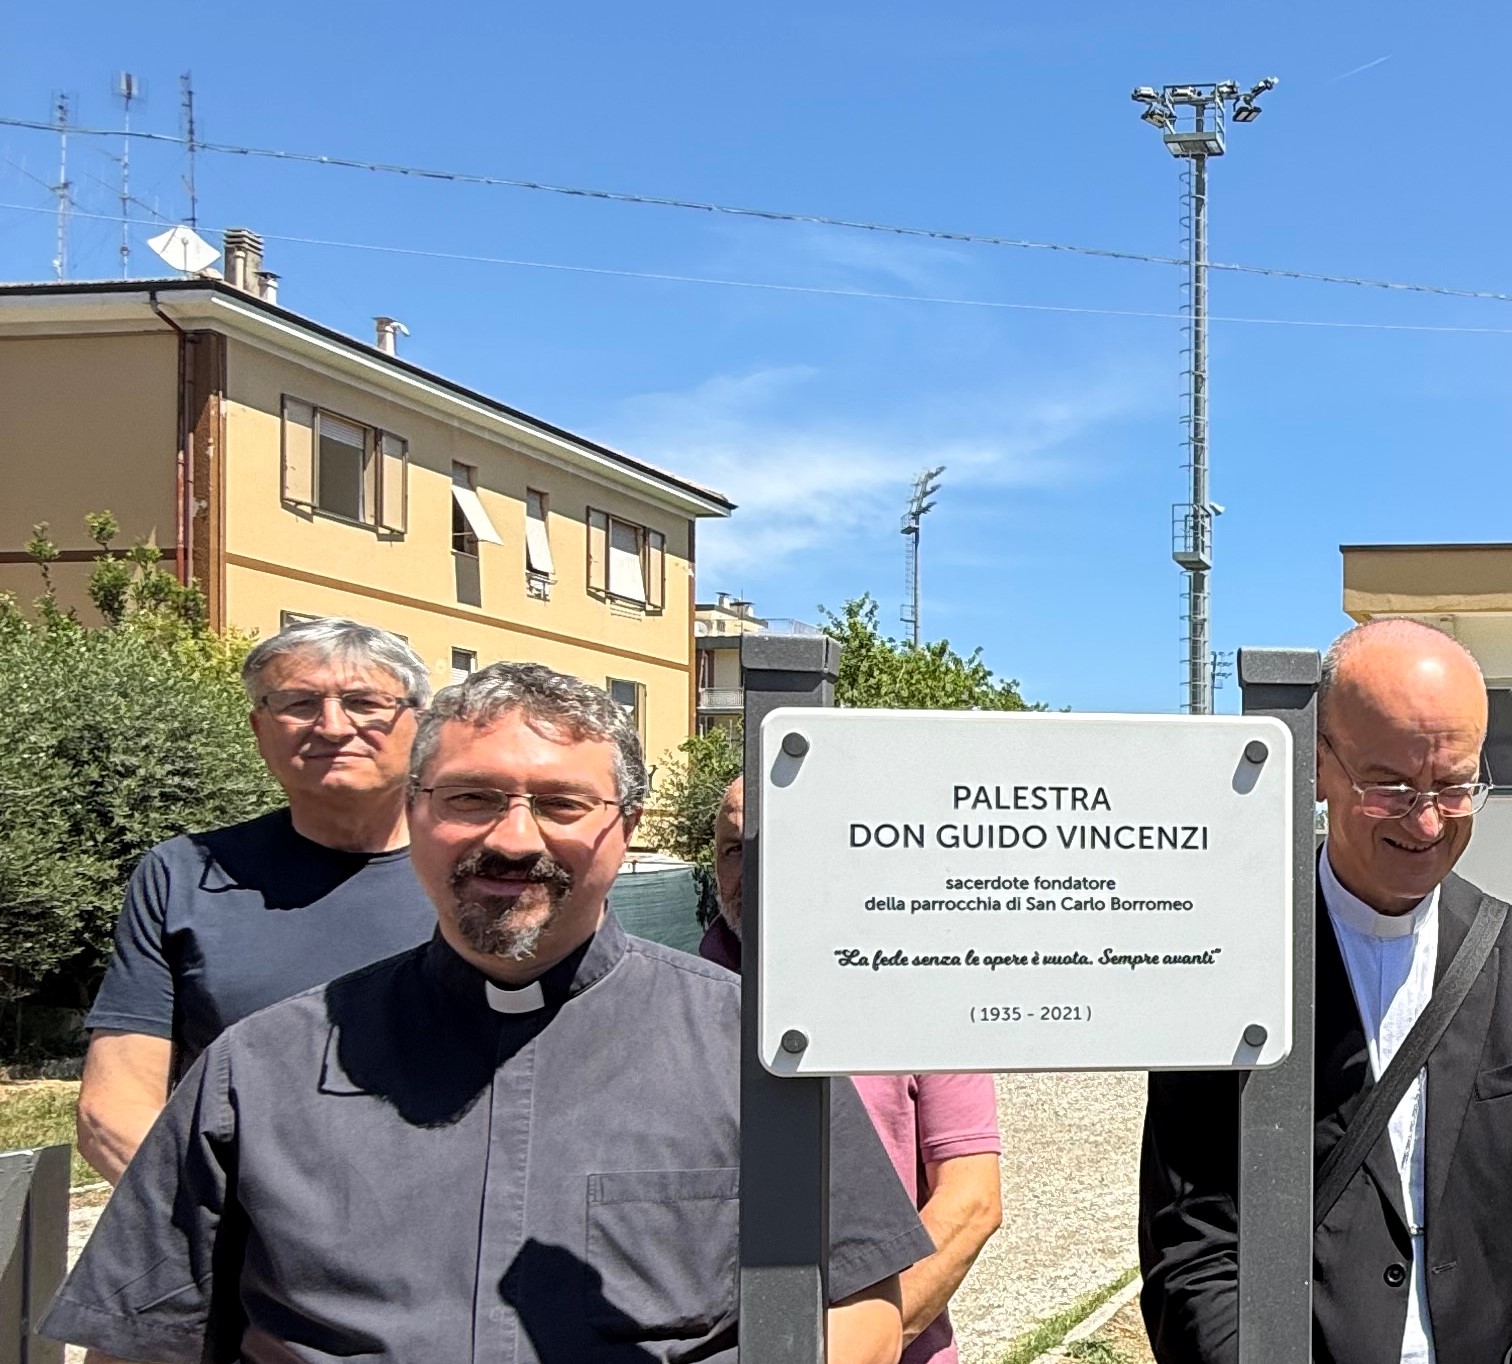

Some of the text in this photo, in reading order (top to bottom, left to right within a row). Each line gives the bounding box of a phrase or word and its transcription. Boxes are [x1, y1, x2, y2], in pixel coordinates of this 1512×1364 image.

[954, 786, 1111, 811] PALESTRA
[850, 824, 1207, 850] DON GUIDO VINCENZI
[946, 876, 1116, 891] sacerdote fondatore
[865, 897, 1193, 914] della parrocchia di San Carlo Borromeo
[872, 949, 909, 971] fede
[912, 955, 961, 966] senza
[965, 949, 980, 966] le
[983, 954, 1028, 971] opere
[1031, 951, 1039, 965] è
[1042, 951, 1093, 965] vuota.
[1098, 948, 1159, 970] Sempre
